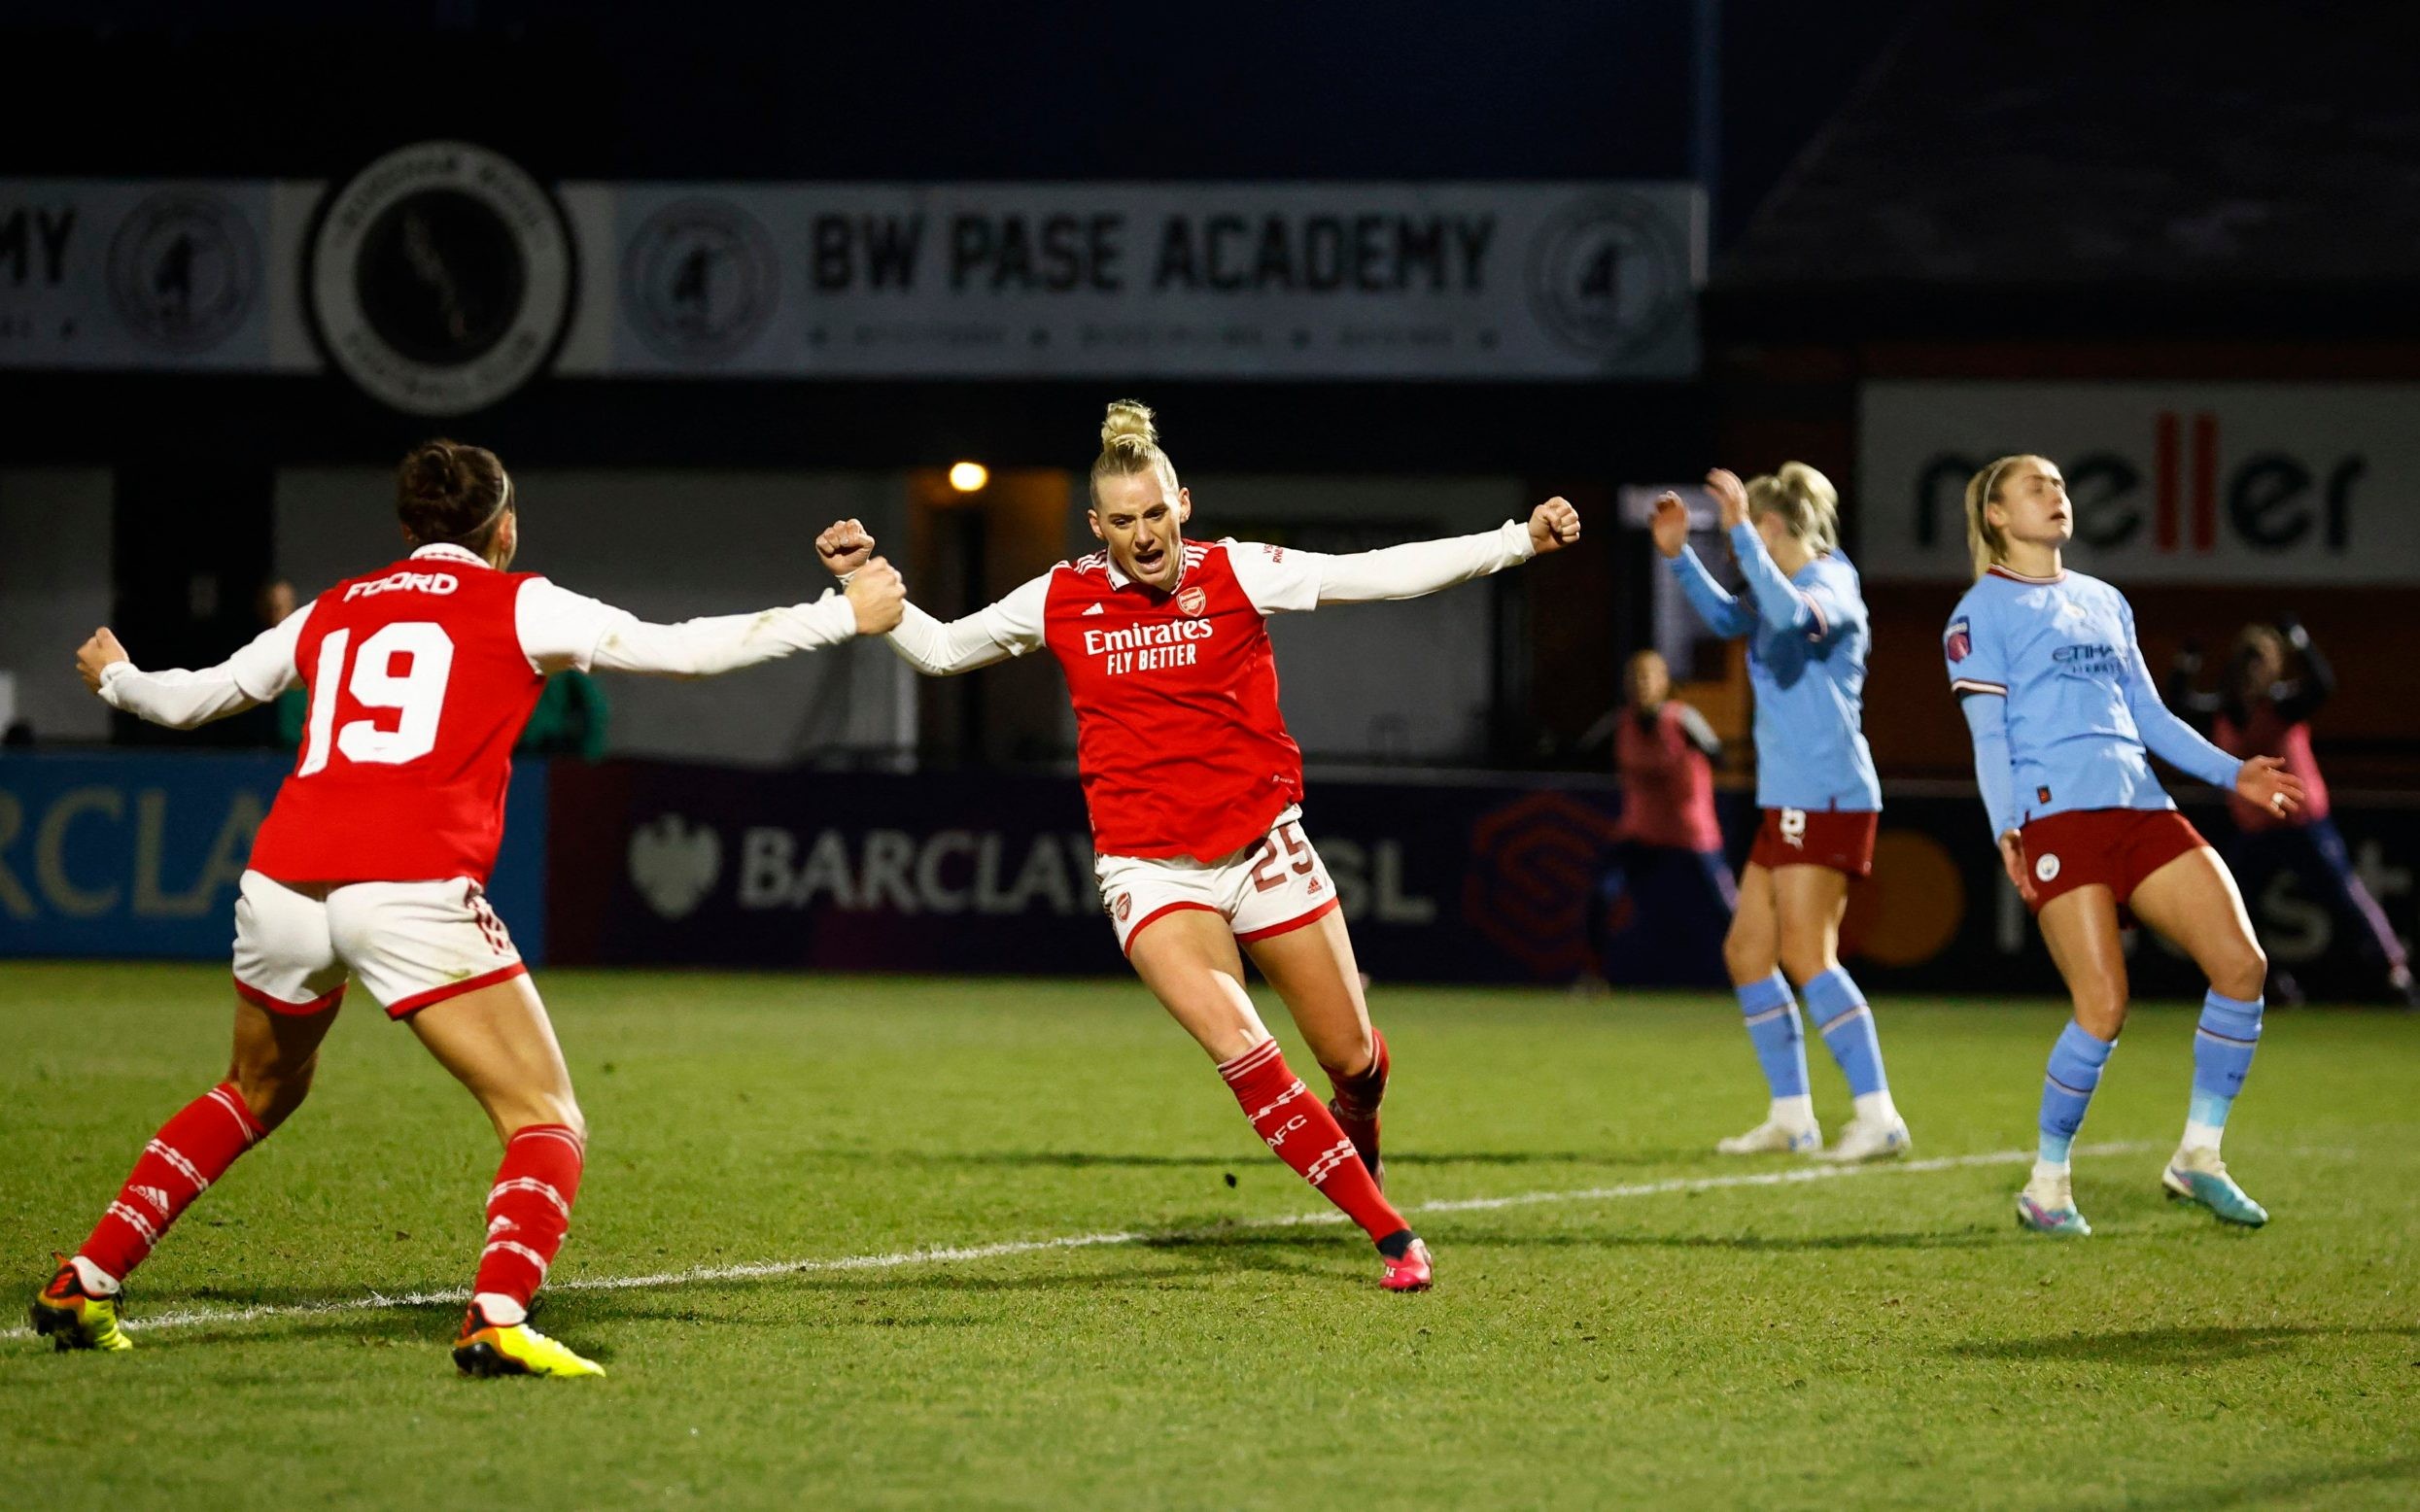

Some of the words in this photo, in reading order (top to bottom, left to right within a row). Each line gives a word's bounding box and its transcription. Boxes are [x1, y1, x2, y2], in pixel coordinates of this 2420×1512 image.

[812, 212, 924, 291] BW
[950, 212, 1125, 291] PASE
[1157, 213, 1497, 291] ACADEMY
[342, 571, 458, 602] FOORD
[1084, 618, 1213, 656] Emirates
[1106, 651, 1133, 675] FLY
[1138, 642, 1196, 671] BETTER
[297, 622, 454, 777] 19
[1244, 825, 1313, 893] 25
[1266, 1114, 1307, 1150] AFC
